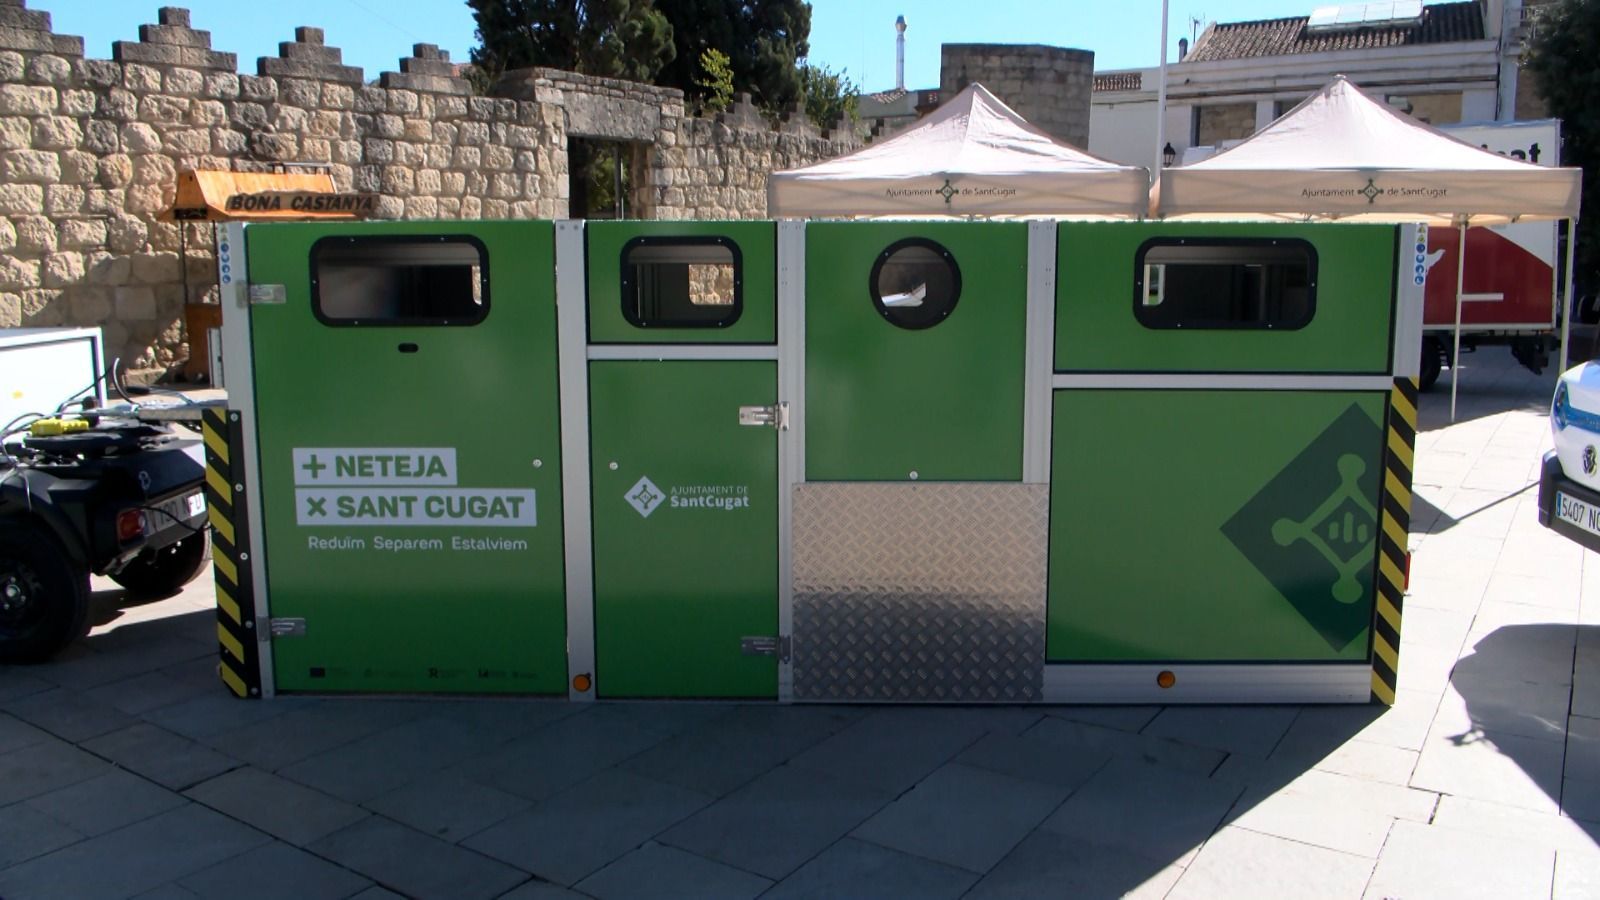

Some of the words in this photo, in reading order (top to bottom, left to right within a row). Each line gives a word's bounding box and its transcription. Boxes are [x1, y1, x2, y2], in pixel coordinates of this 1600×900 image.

[886, 188, 932, 198] Ajuntament
[962, 188, 973, 196] de
[1302, 188, 1354, 197] Ajuntament
[1387, 187, 1399, 196] de
[229, 193, 280, 210] BONA
[291, 195, 373, 210] CASTANYA
[335, 455, 447, 477] NETEJA
[671, 486, 733, 494] AJUNTAMENT
[736, 486, 748, 494] DE
[337, 496, 417, 518] SANT
[424, 496, 524, 518] CUGAT
[671, 495, 749, 510] SantCugat
[1562, 497, 1585, 523] 5407
[373, 537, 443, 552] Separem
[451, 537, 527, 550] Estalviem
